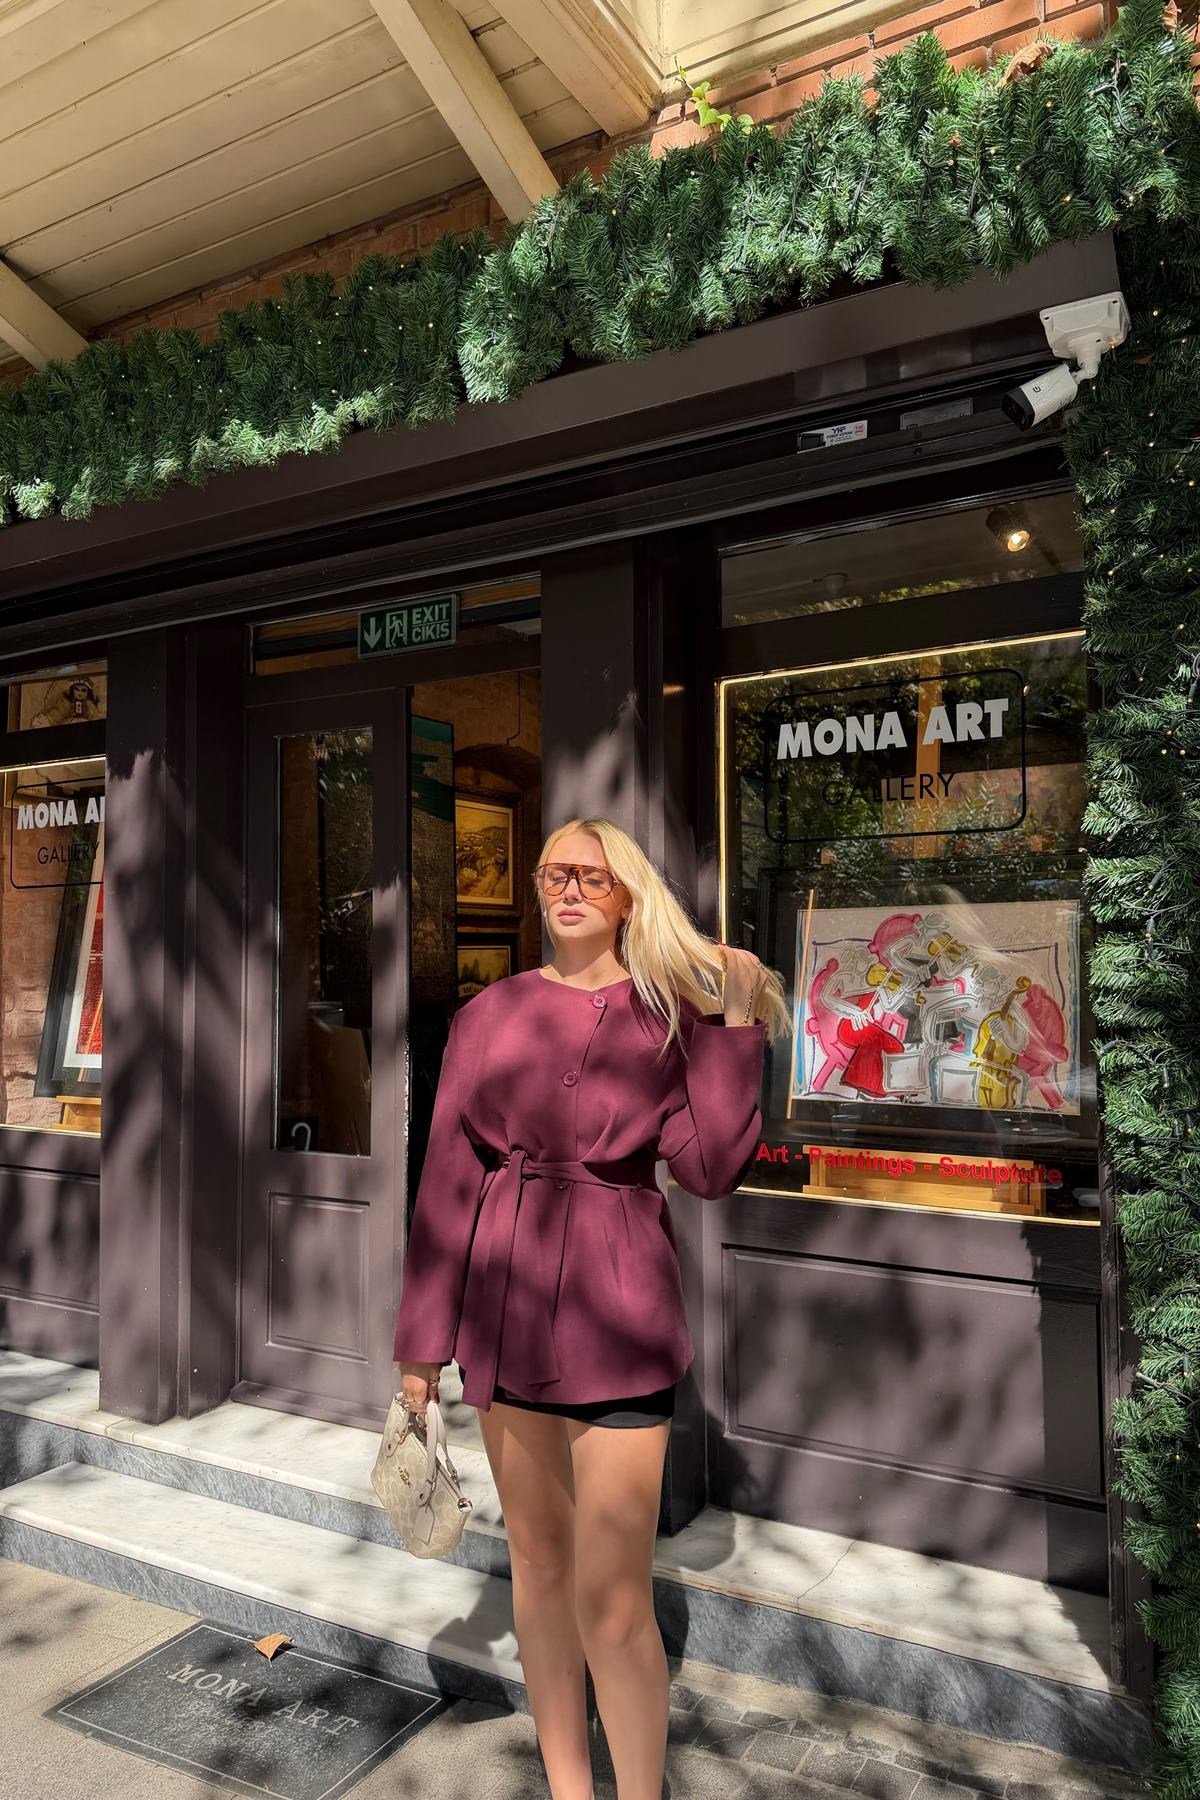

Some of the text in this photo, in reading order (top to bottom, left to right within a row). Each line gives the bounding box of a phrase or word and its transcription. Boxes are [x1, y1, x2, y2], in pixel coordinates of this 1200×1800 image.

[412, 603, 450, 625] EXIT
[777, 698, 1009, 760] MONA ART
[822, 772, 956, 805] GALLERY
[17, 799, 79, 830] MONA
[37, 841, 100, 865] GALLERY
[756, 1143, 789, 1164] Art
[809, 1147, 916, 1177] Paintings
[939, 1156, 1063, 1185] Sculpture
[167, 1663, 360, 1736] MONA ART
